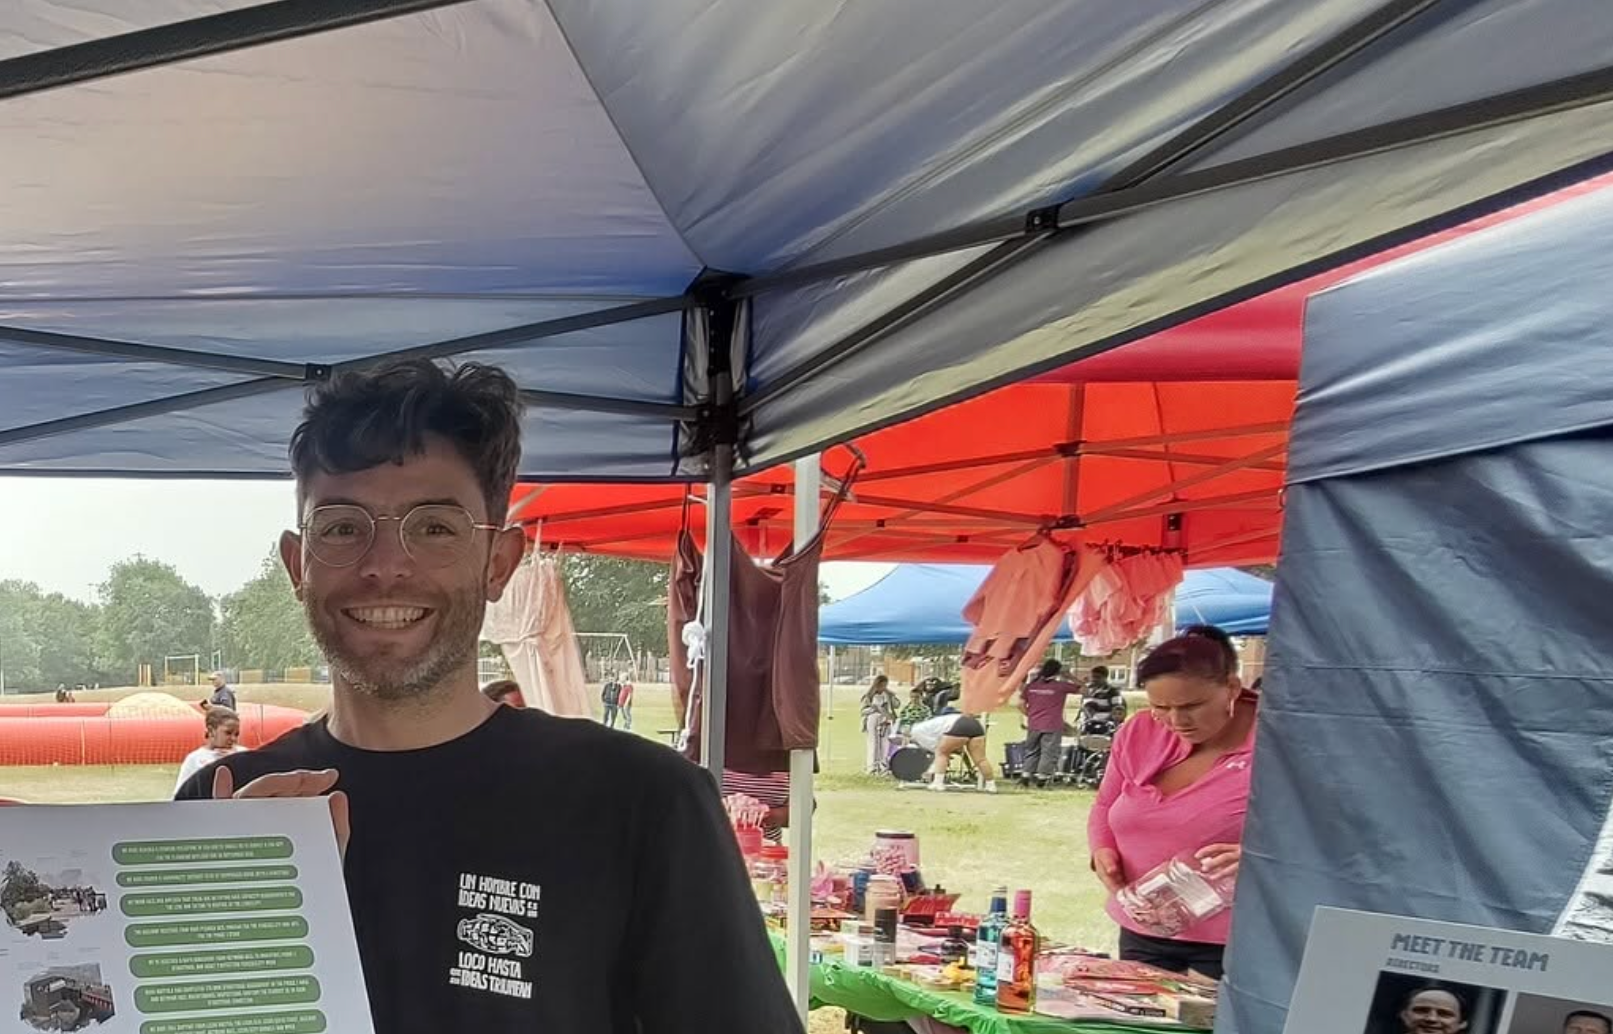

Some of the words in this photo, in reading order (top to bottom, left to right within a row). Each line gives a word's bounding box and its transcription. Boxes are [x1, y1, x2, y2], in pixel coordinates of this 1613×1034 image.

[459, 872, 477, 890] UN
[478, 876, 518, 896] HOMBRE
[519, 882, 541, 900] CON
[458, 889, 487, 909] IDEAS
[489, 895, 526, 915] NUEVAS
[458, 951, 486, 971] LOCO
[487, 957, 522, 979] HASTA
[1390, 932, 1446, 956] MEET
[1448, 940, 1483, 963] THE
[1491, 946, 1550, 972] TEAM
[460, 969, 488, 990] IDEAS
